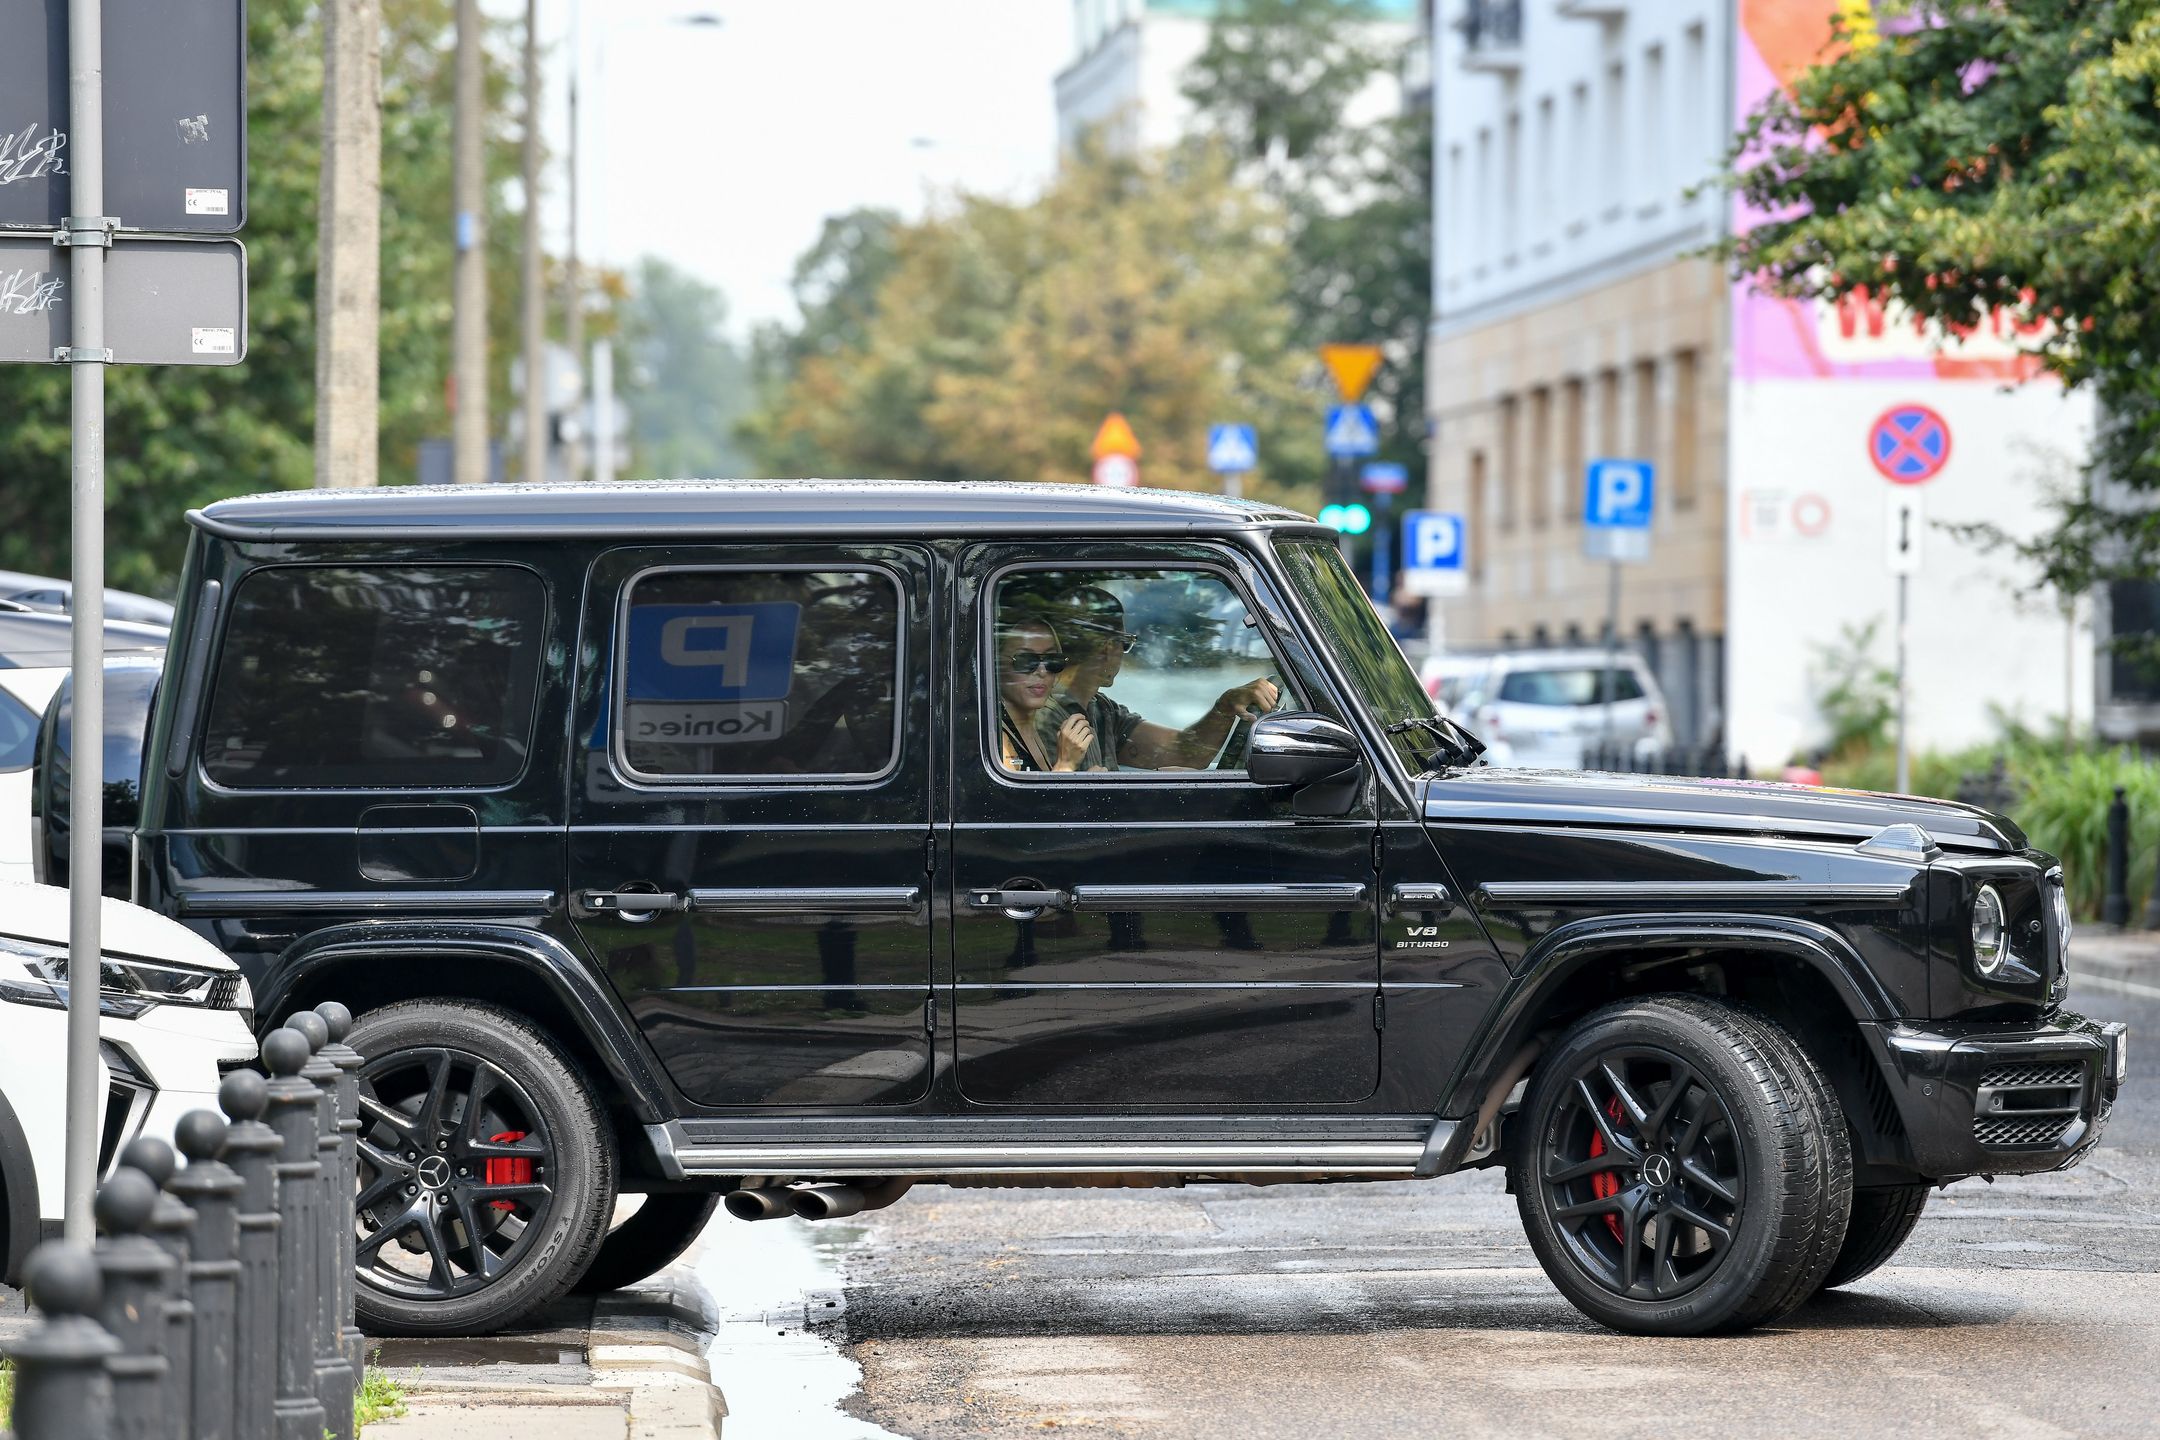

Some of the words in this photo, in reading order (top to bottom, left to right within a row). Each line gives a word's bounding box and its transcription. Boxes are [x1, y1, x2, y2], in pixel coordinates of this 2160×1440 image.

[1596, 466, 1644, 520] P
[1414, 516, 1456, 568] P
[1406, 926, 1438, 936] V8
